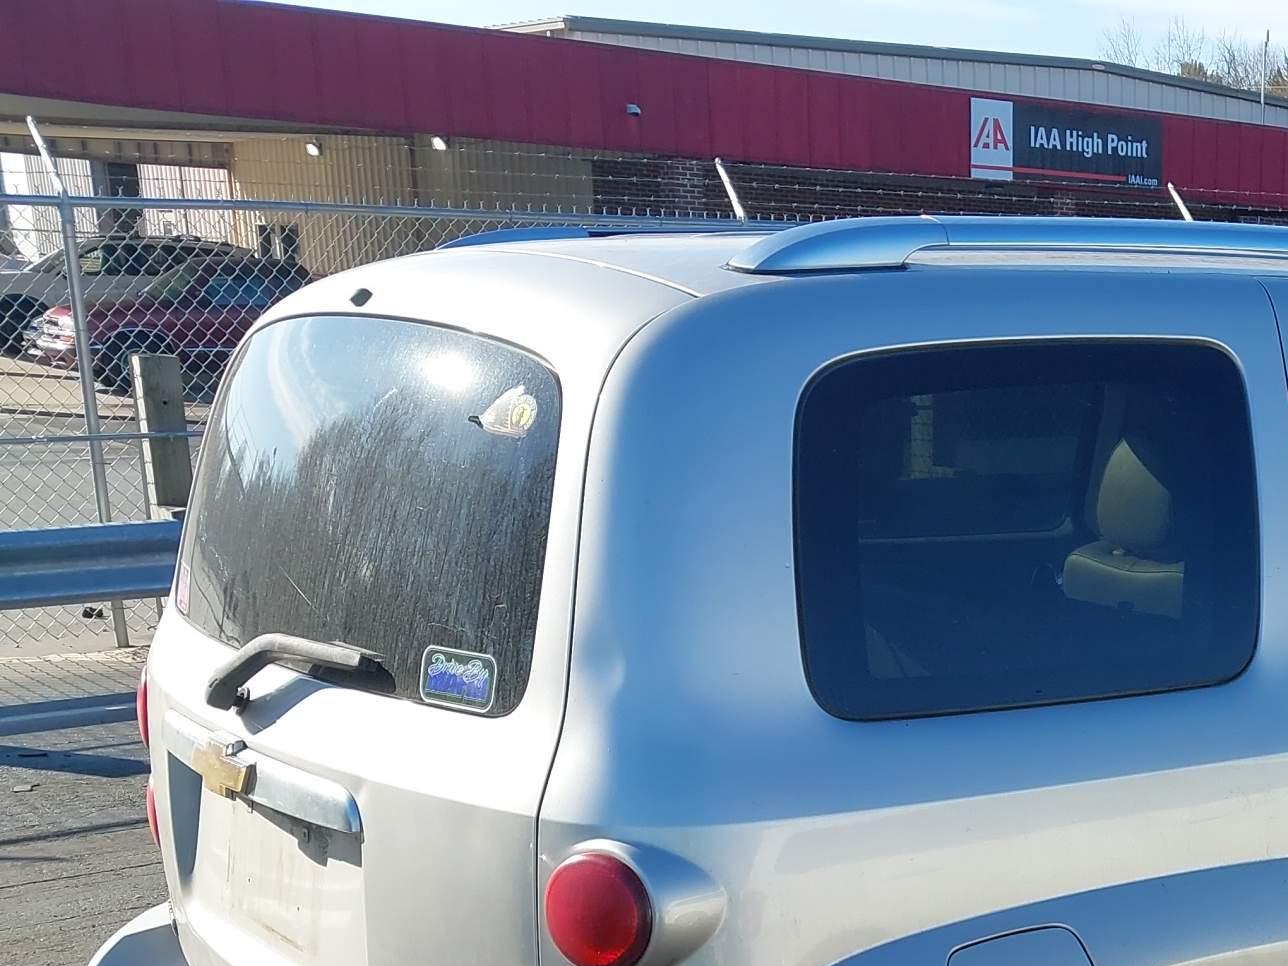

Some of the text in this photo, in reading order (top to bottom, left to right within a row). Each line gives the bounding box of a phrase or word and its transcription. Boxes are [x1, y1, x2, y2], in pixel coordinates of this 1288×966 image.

[1030, 125, 1148, 158] IAA High Point
[1127, 174, 1158, 187] IAAI.com
